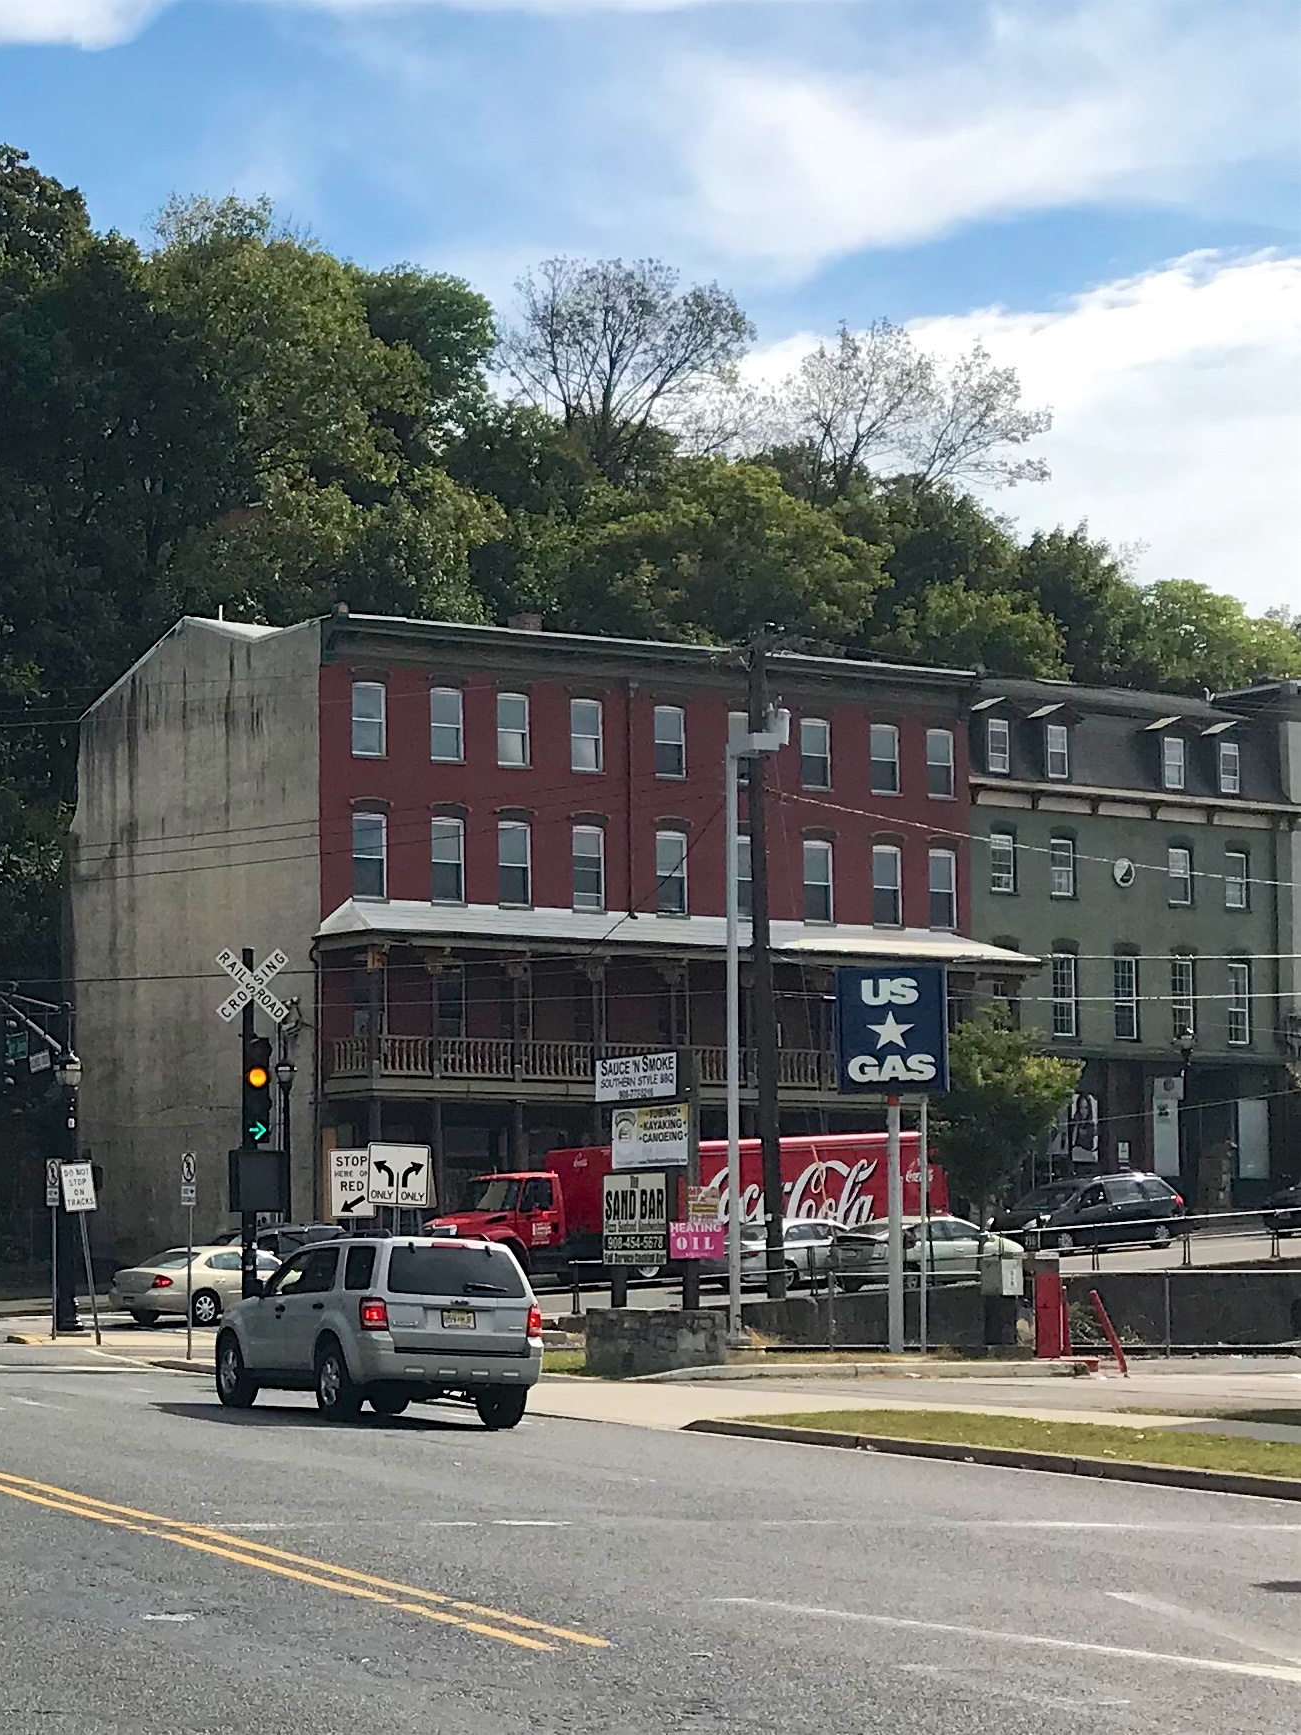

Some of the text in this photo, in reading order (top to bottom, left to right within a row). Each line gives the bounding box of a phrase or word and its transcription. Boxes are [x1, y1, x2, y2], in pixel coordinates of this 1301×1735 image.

[220, 953, 285, 1018] CROSSING
[861, 977, 919, 1006] US
[848, 1054, 937, 1083] GAS
[600, 1077, 636, 1089] SOUTHERN
[638, 1074, 658, 1086] STYLE
[643, 1118, 683, 1130] KAYAKING
[642, 1131, 684, 1143] CANOEING
[336, 1155, 368, 1167] STOP
[63, 1169, 74, 1177] DO
[68, 1177, 87, 1187] STOP
[340, 1180, 365, 1191] RED
[74, 1188, 85, 1196] ON
[370, 1189, 425, 1201] ONLY ONLY
[67, 1197, 94, 1207] TRACKS
[605, 1189, 636, 1220] SAND
[640, 1188, 664, 1219] BAR
[670, 1222, 722, 1233] HEATING
